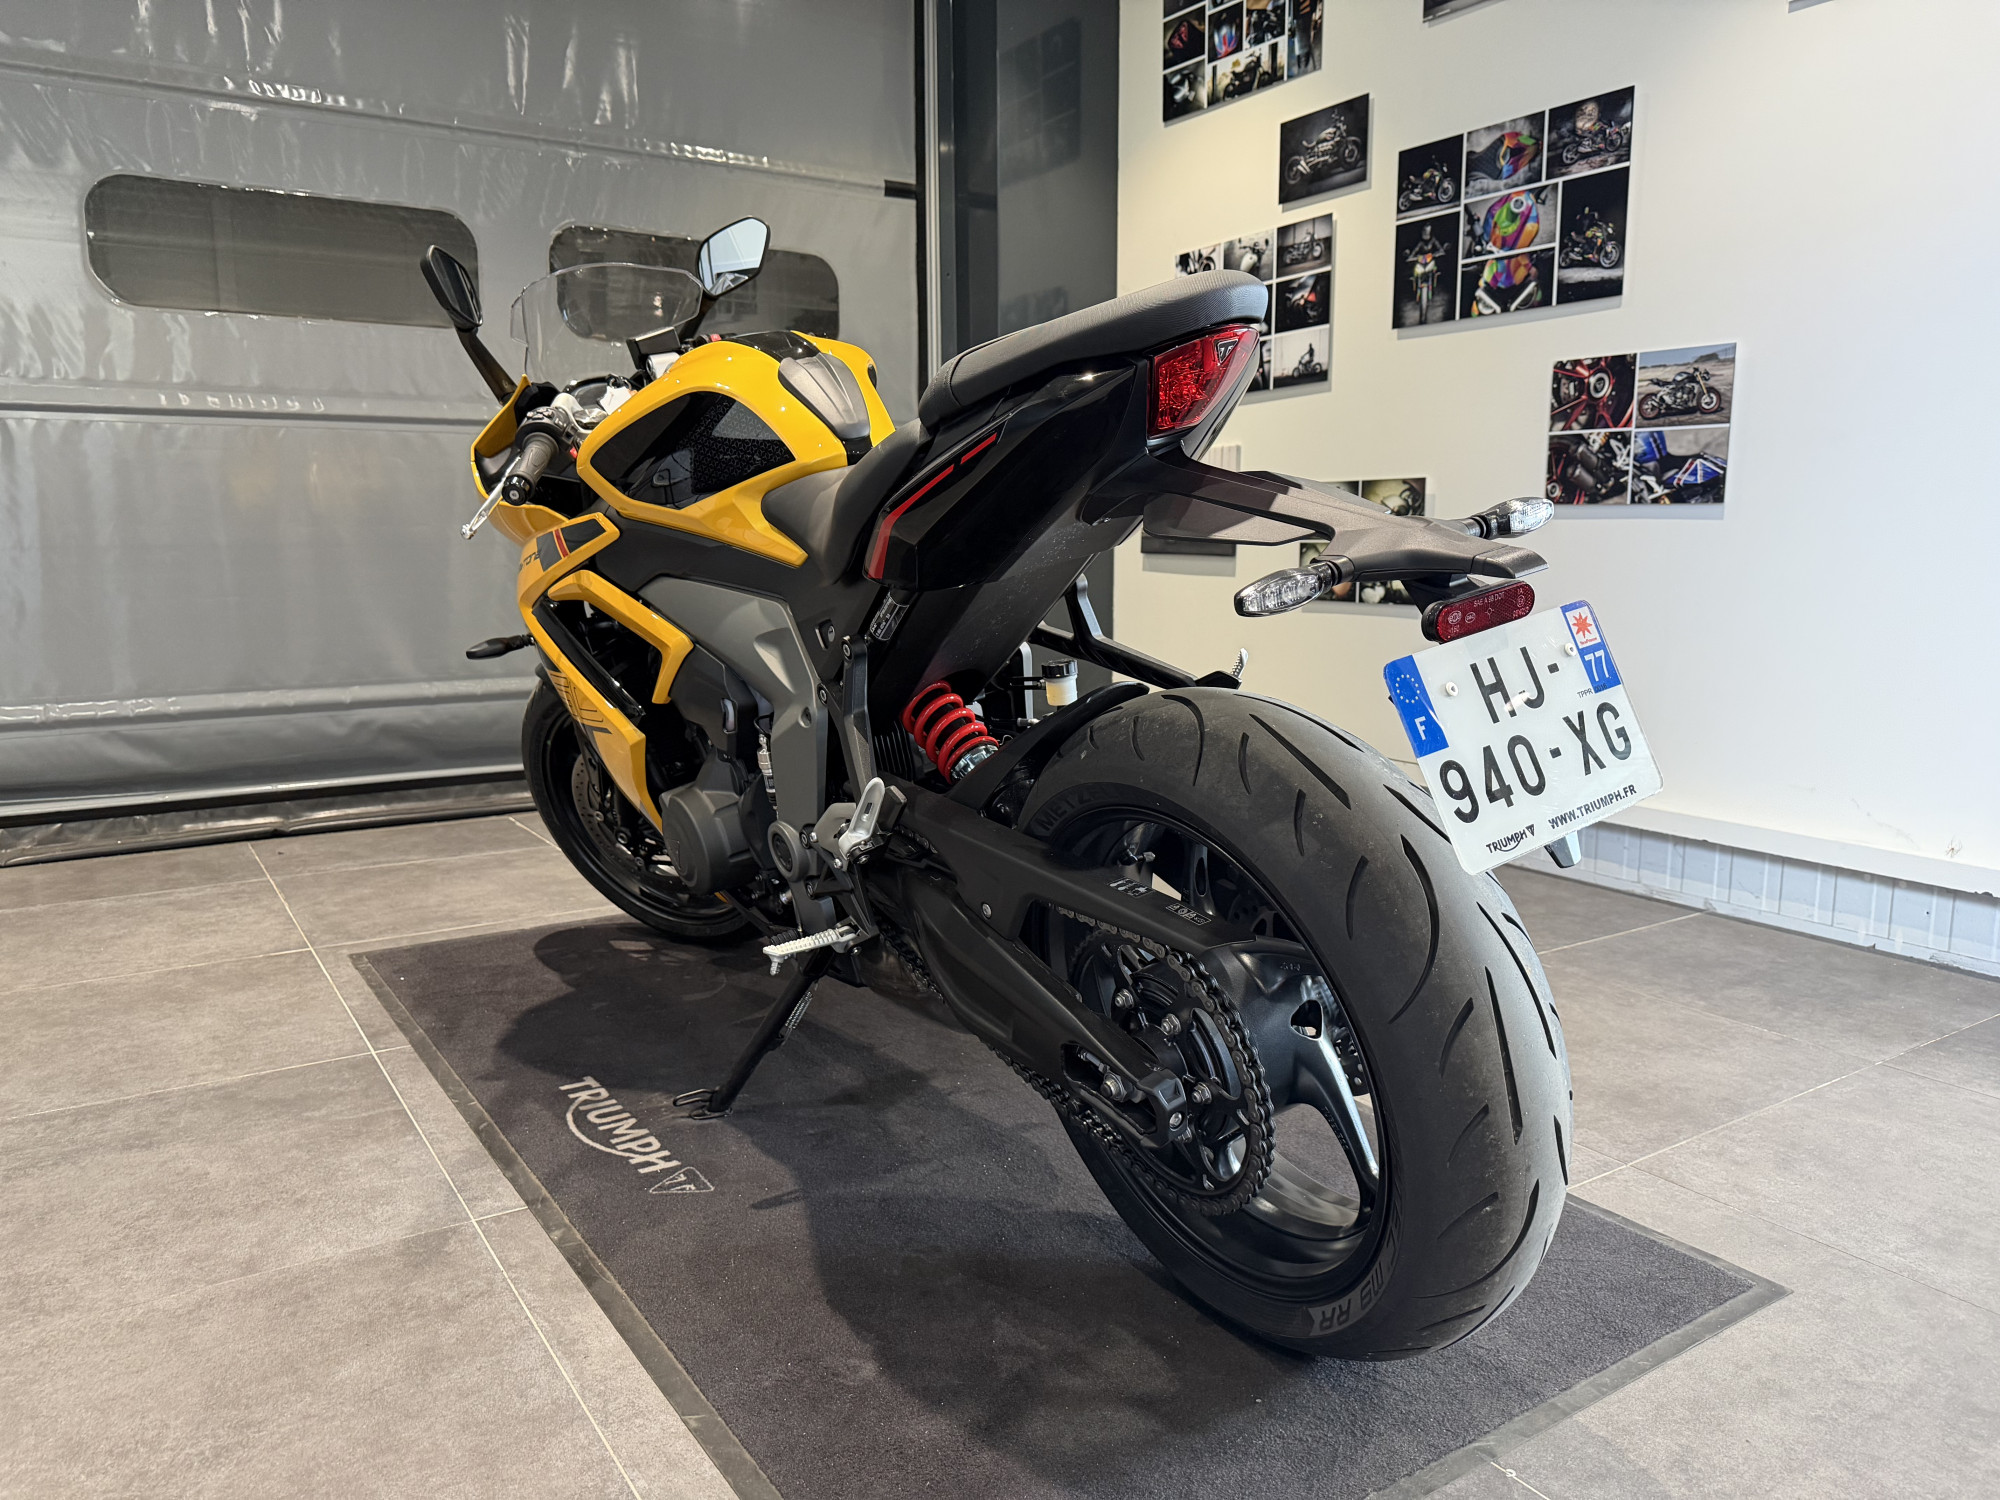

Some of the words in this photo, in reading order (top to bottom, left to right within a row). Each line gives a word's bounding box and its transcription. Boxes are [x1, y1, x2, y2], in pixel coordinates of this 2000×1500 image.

[1469, 646, 1560, 724] HJ-
[1584, 649, 1610, 682] 77
[1414, 716, 1426, 741] F
[1439, 701, 1632, 824] 940-XG
[1548, 784, 1637, 830] WWW.TRIUMPH.FR
[1486, 829, 1528, 853] TRIUMPH
[558, 1075, 682, 1174] TRIUMPH
[1319, 1298, 1351, 1331] RR
